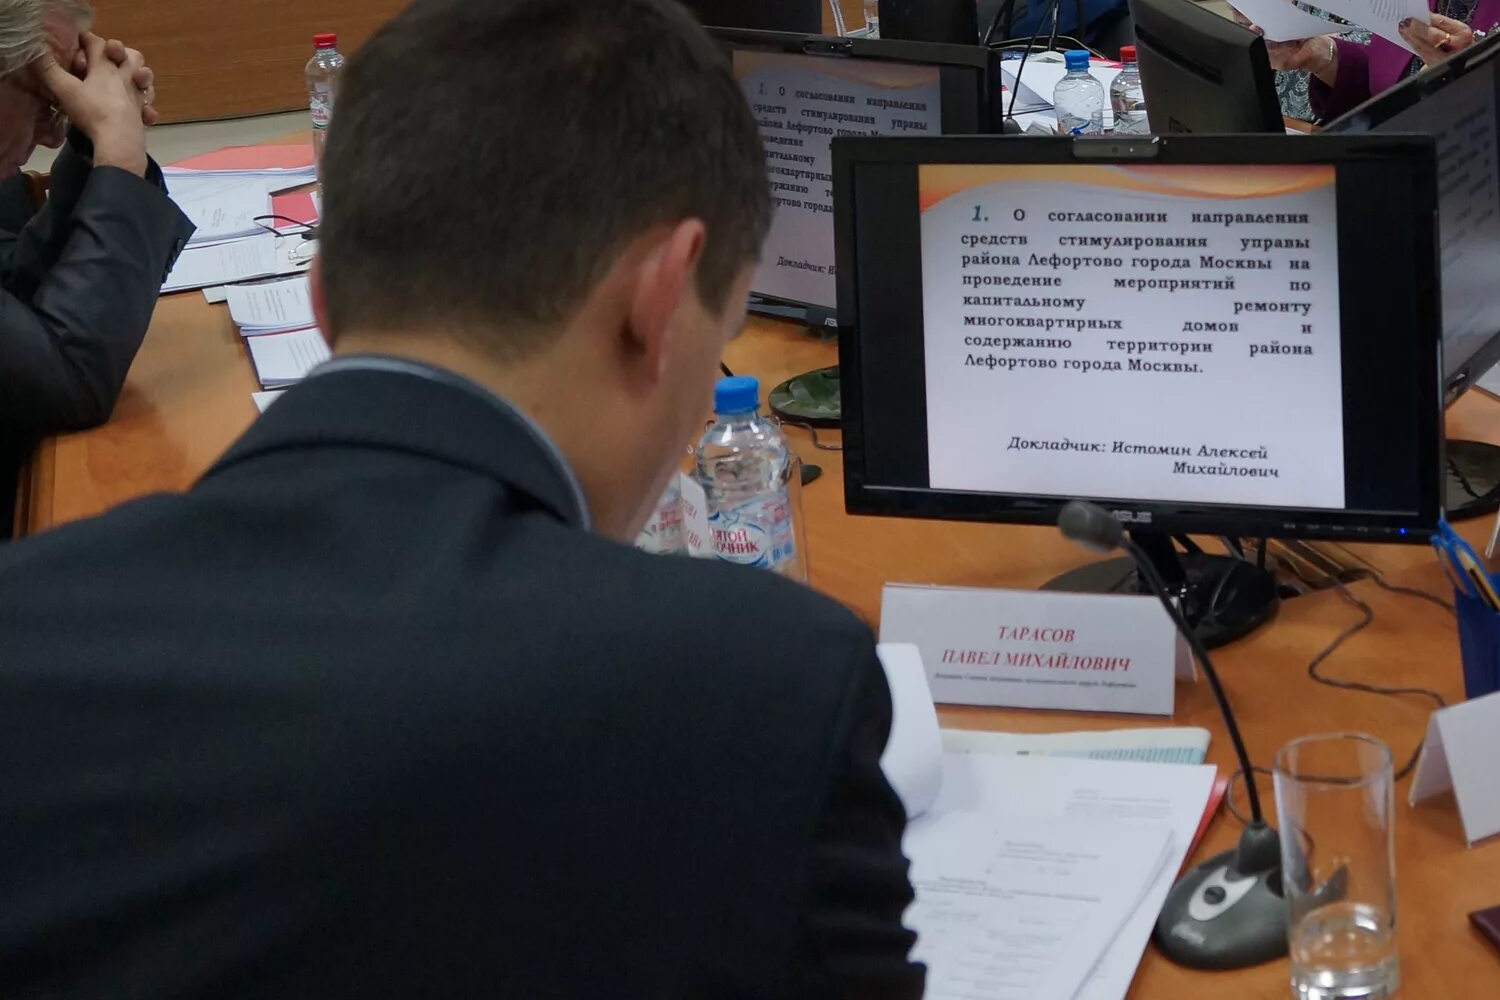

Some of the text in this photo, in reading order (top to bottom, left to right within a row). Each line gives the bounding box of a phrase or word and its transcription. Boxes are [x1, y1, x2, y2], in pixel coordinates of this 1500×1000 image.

[786, 120, 833, 136] Лефортово
[971, 204, 1309, 228] 1. О согласовании направления
[960, 234, 1310, 252] средств стимулирования управы
[961, 251, 1311, 271] района Лефортово города Москвы на
[962, 273, 1312, 293] проведение мероприятий по
[962, 295, 1313, 316] капитальному ремонту
[963, 315, 1313, 335] многоквартирных домов и
[963, 335, 1314, 357] содержанию территории района
[964, 354, 1204, 374] Лефортово города Москвы.
[1006, 436, 1268, 460] Докладчик: Истомин Алексей
[1172, 461, 1280, 478] Михайлович
[998, 625, 1076, 643] ТАРАСОВ
[942, 649, 1132, 673] ПАВЕЛ МИХАЙЛОВИЧ
